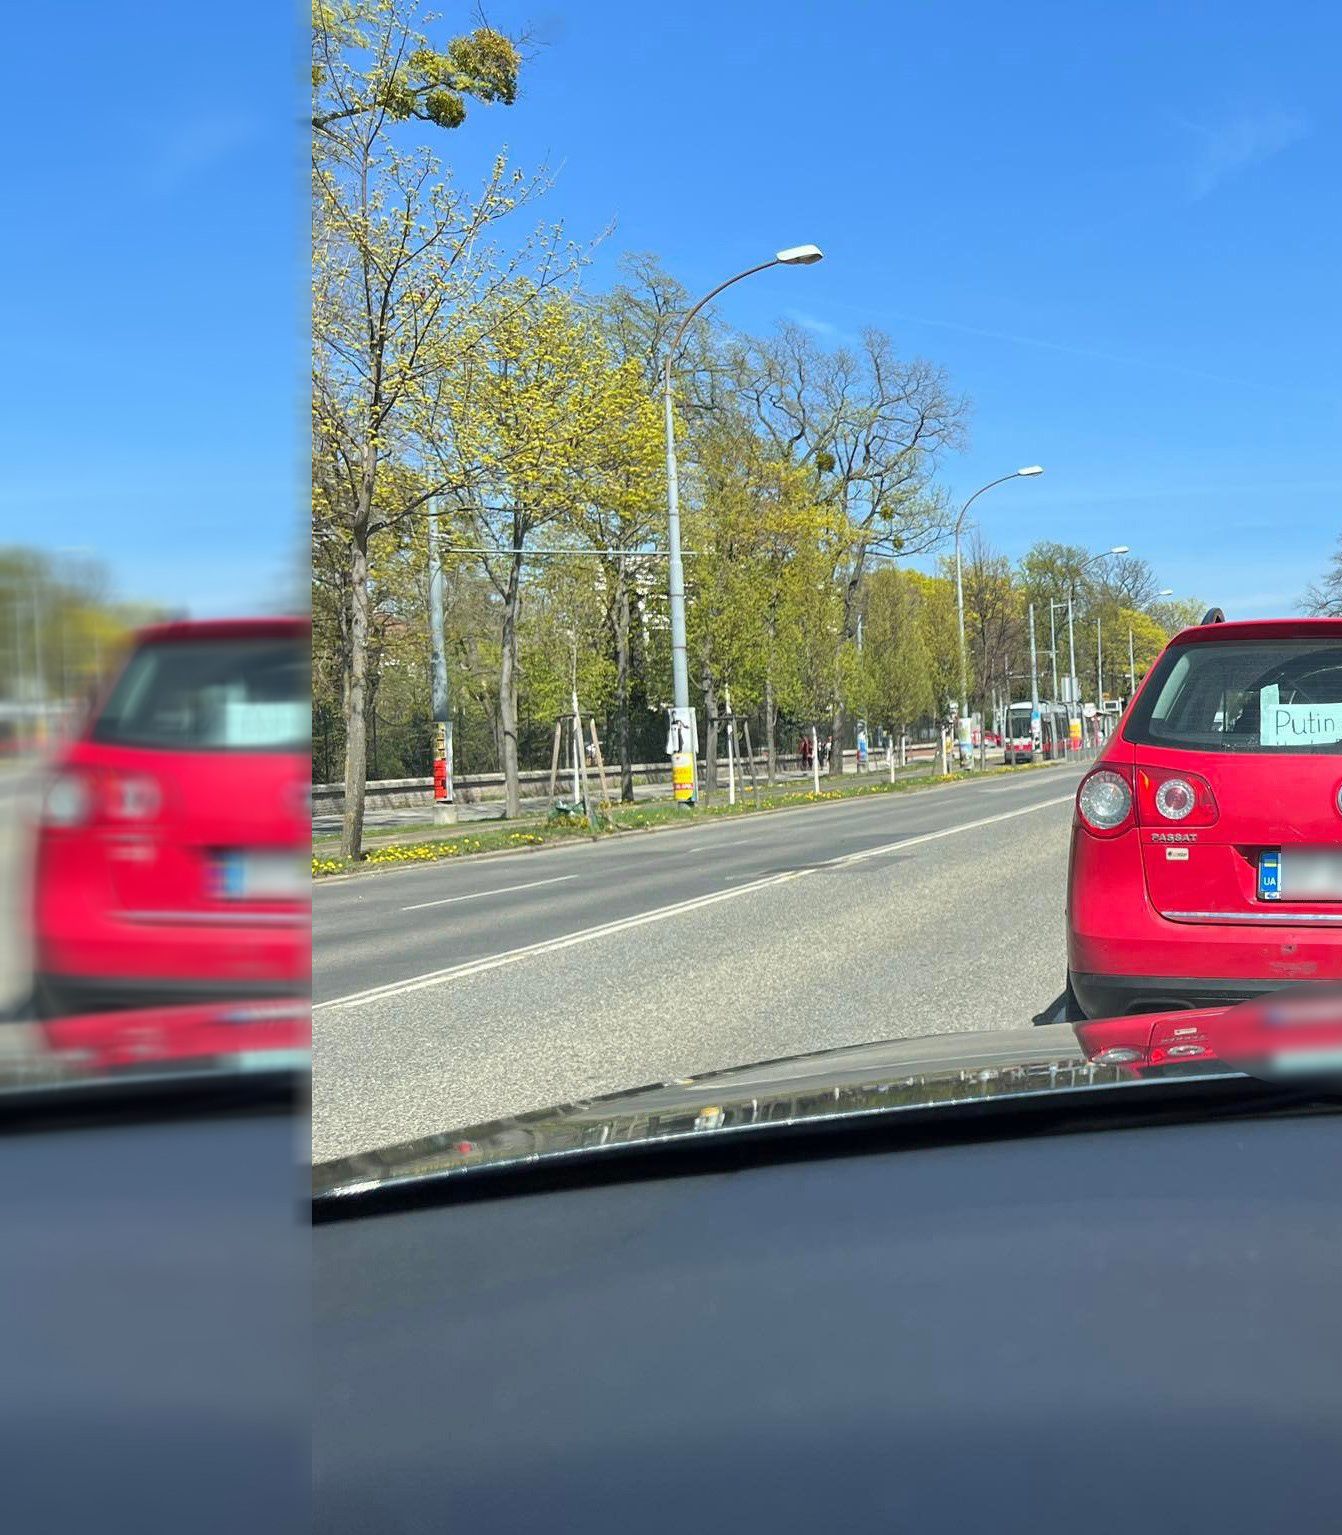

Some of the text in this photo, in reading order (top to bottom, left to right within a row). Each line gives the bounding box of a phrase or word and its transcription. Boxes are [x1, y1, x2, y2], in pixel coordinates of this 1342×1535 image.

[1275, 709, 1336, 735] Putin
[1151, 832, 1198, 843] PASSAT
[1263, 876, 1277, 887] UA
